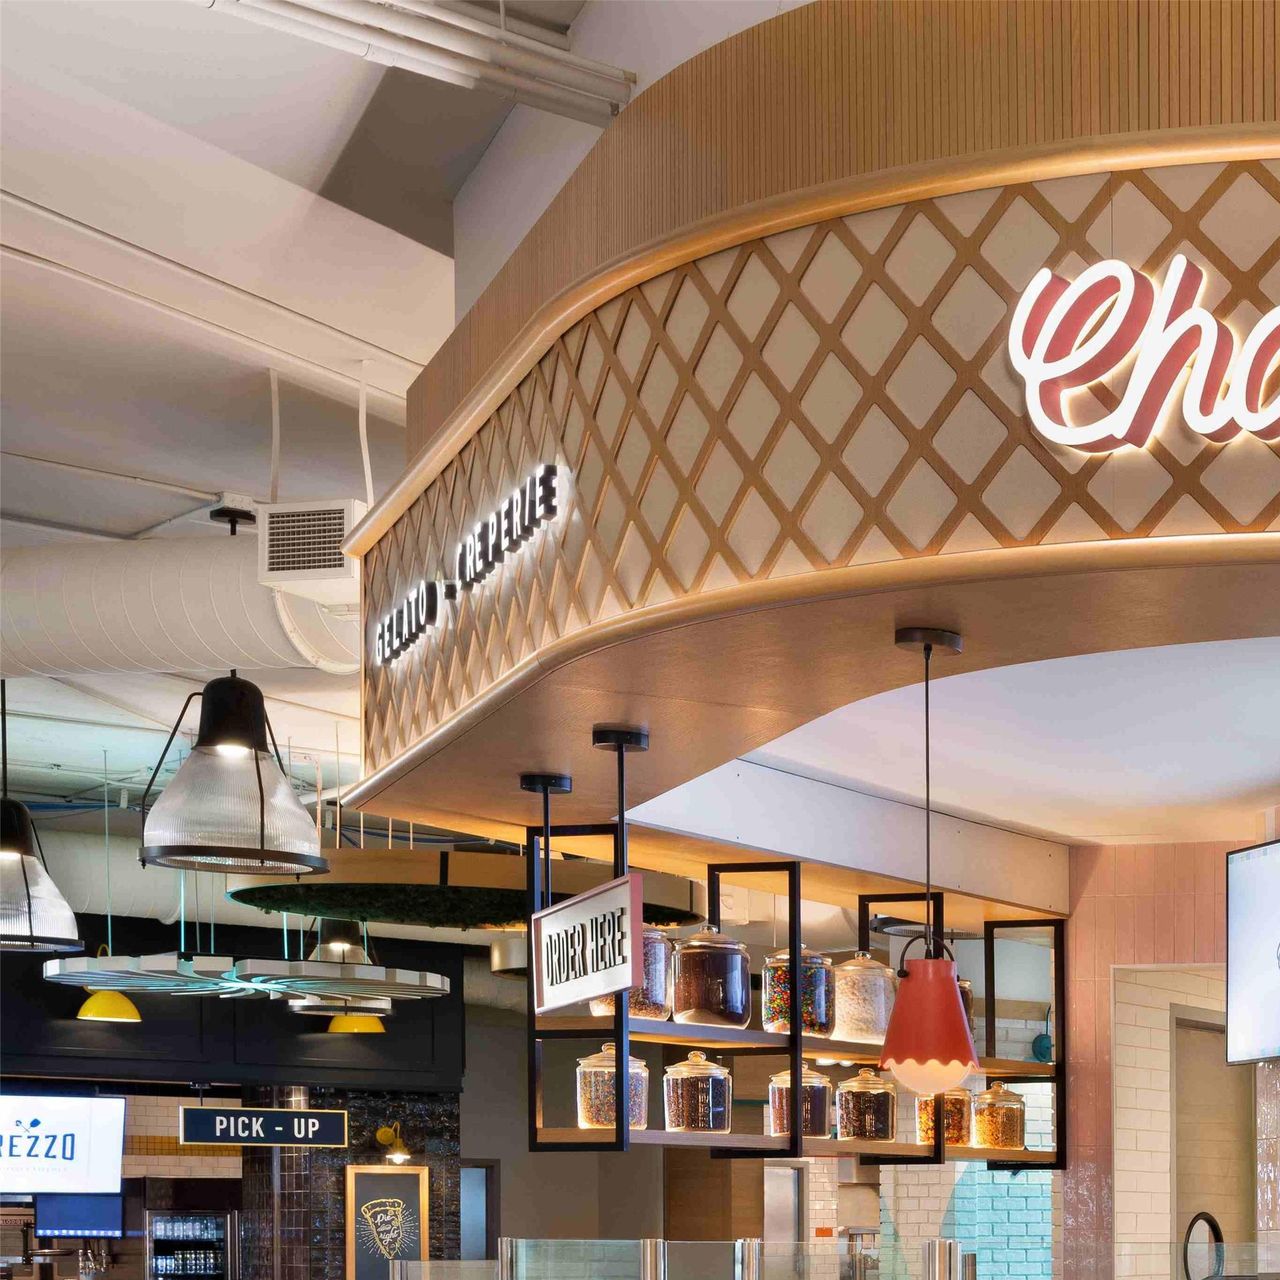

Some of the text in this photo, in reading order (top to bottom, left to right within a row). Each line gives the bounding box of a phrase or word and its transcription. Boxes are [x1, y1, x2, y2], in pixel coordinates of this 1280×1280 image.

[375, 463, 559, 666] GELATO CREPERIE
[546, 906, 627, 986] ORDER HERE
[215, 1116, 265, 1138] PICK
[293, 1118, 320, 1139] UP
